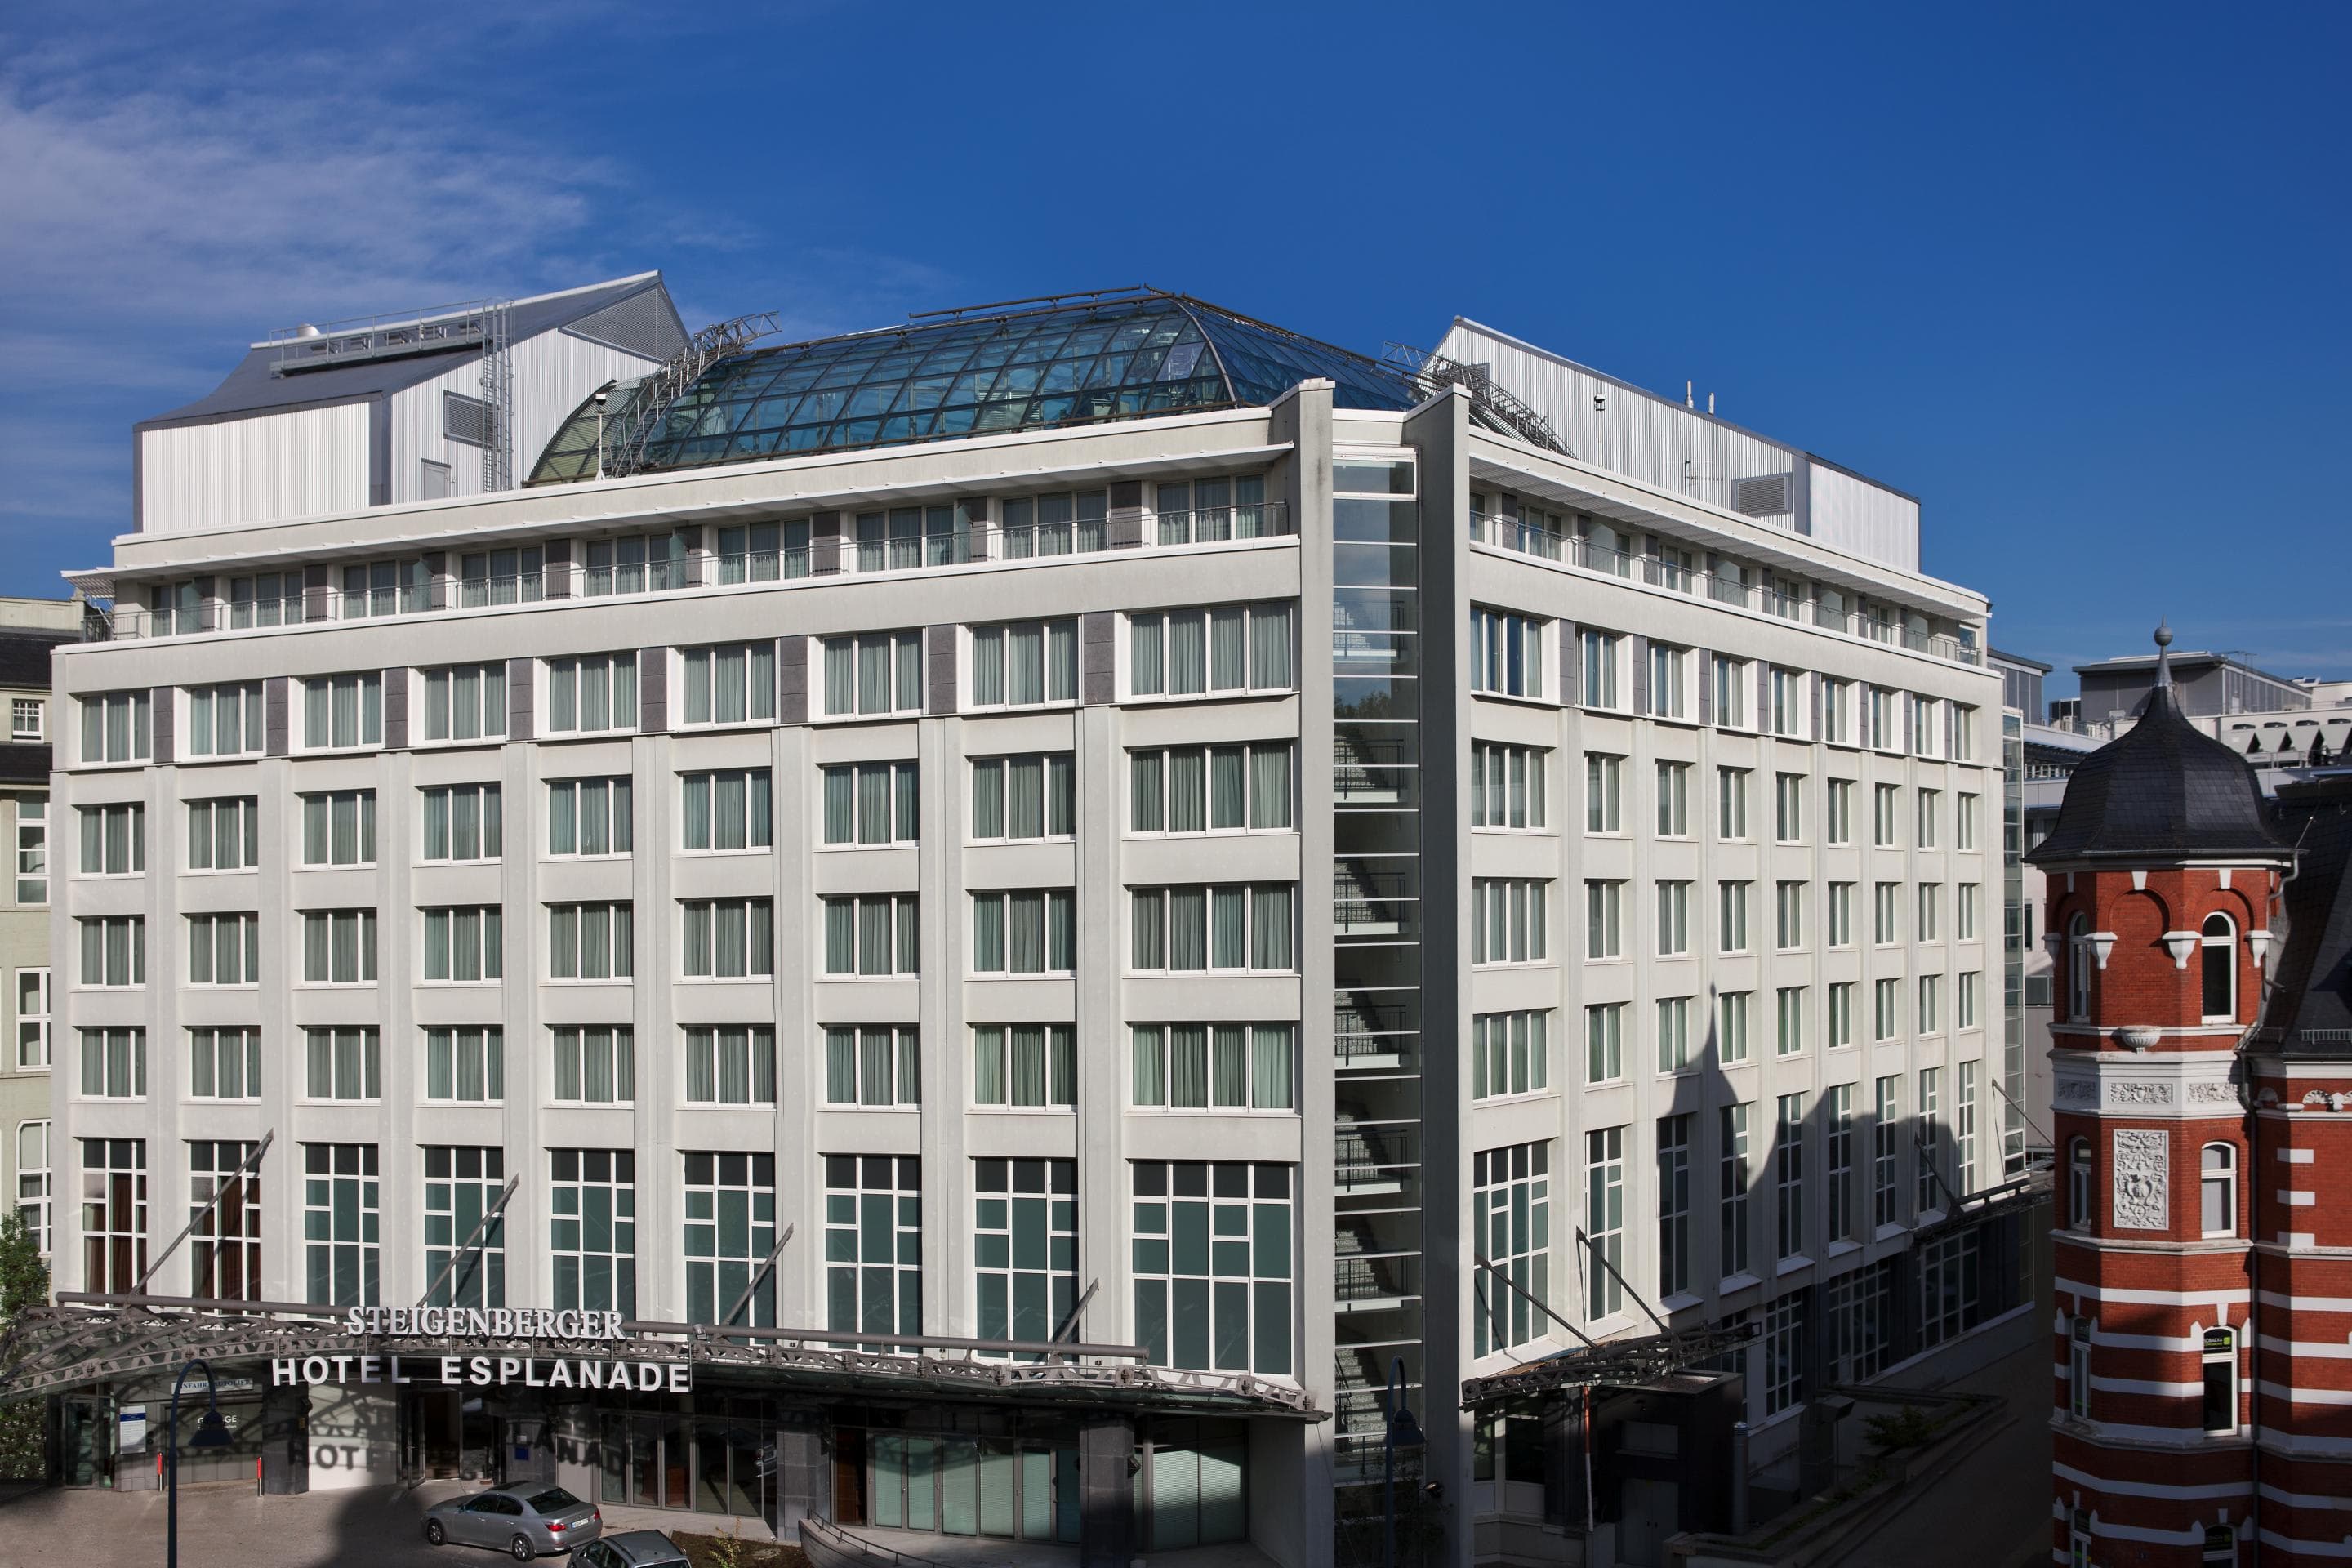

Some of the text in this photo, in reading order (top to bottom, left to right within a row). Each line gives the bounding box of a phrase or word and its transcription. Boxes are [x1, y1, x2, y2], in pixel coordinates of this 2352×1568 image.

[348, 1306, 626, 1340] STEIGENBERGER
[272, 1355, 691, 1393] HOTEL ESPLANADE
